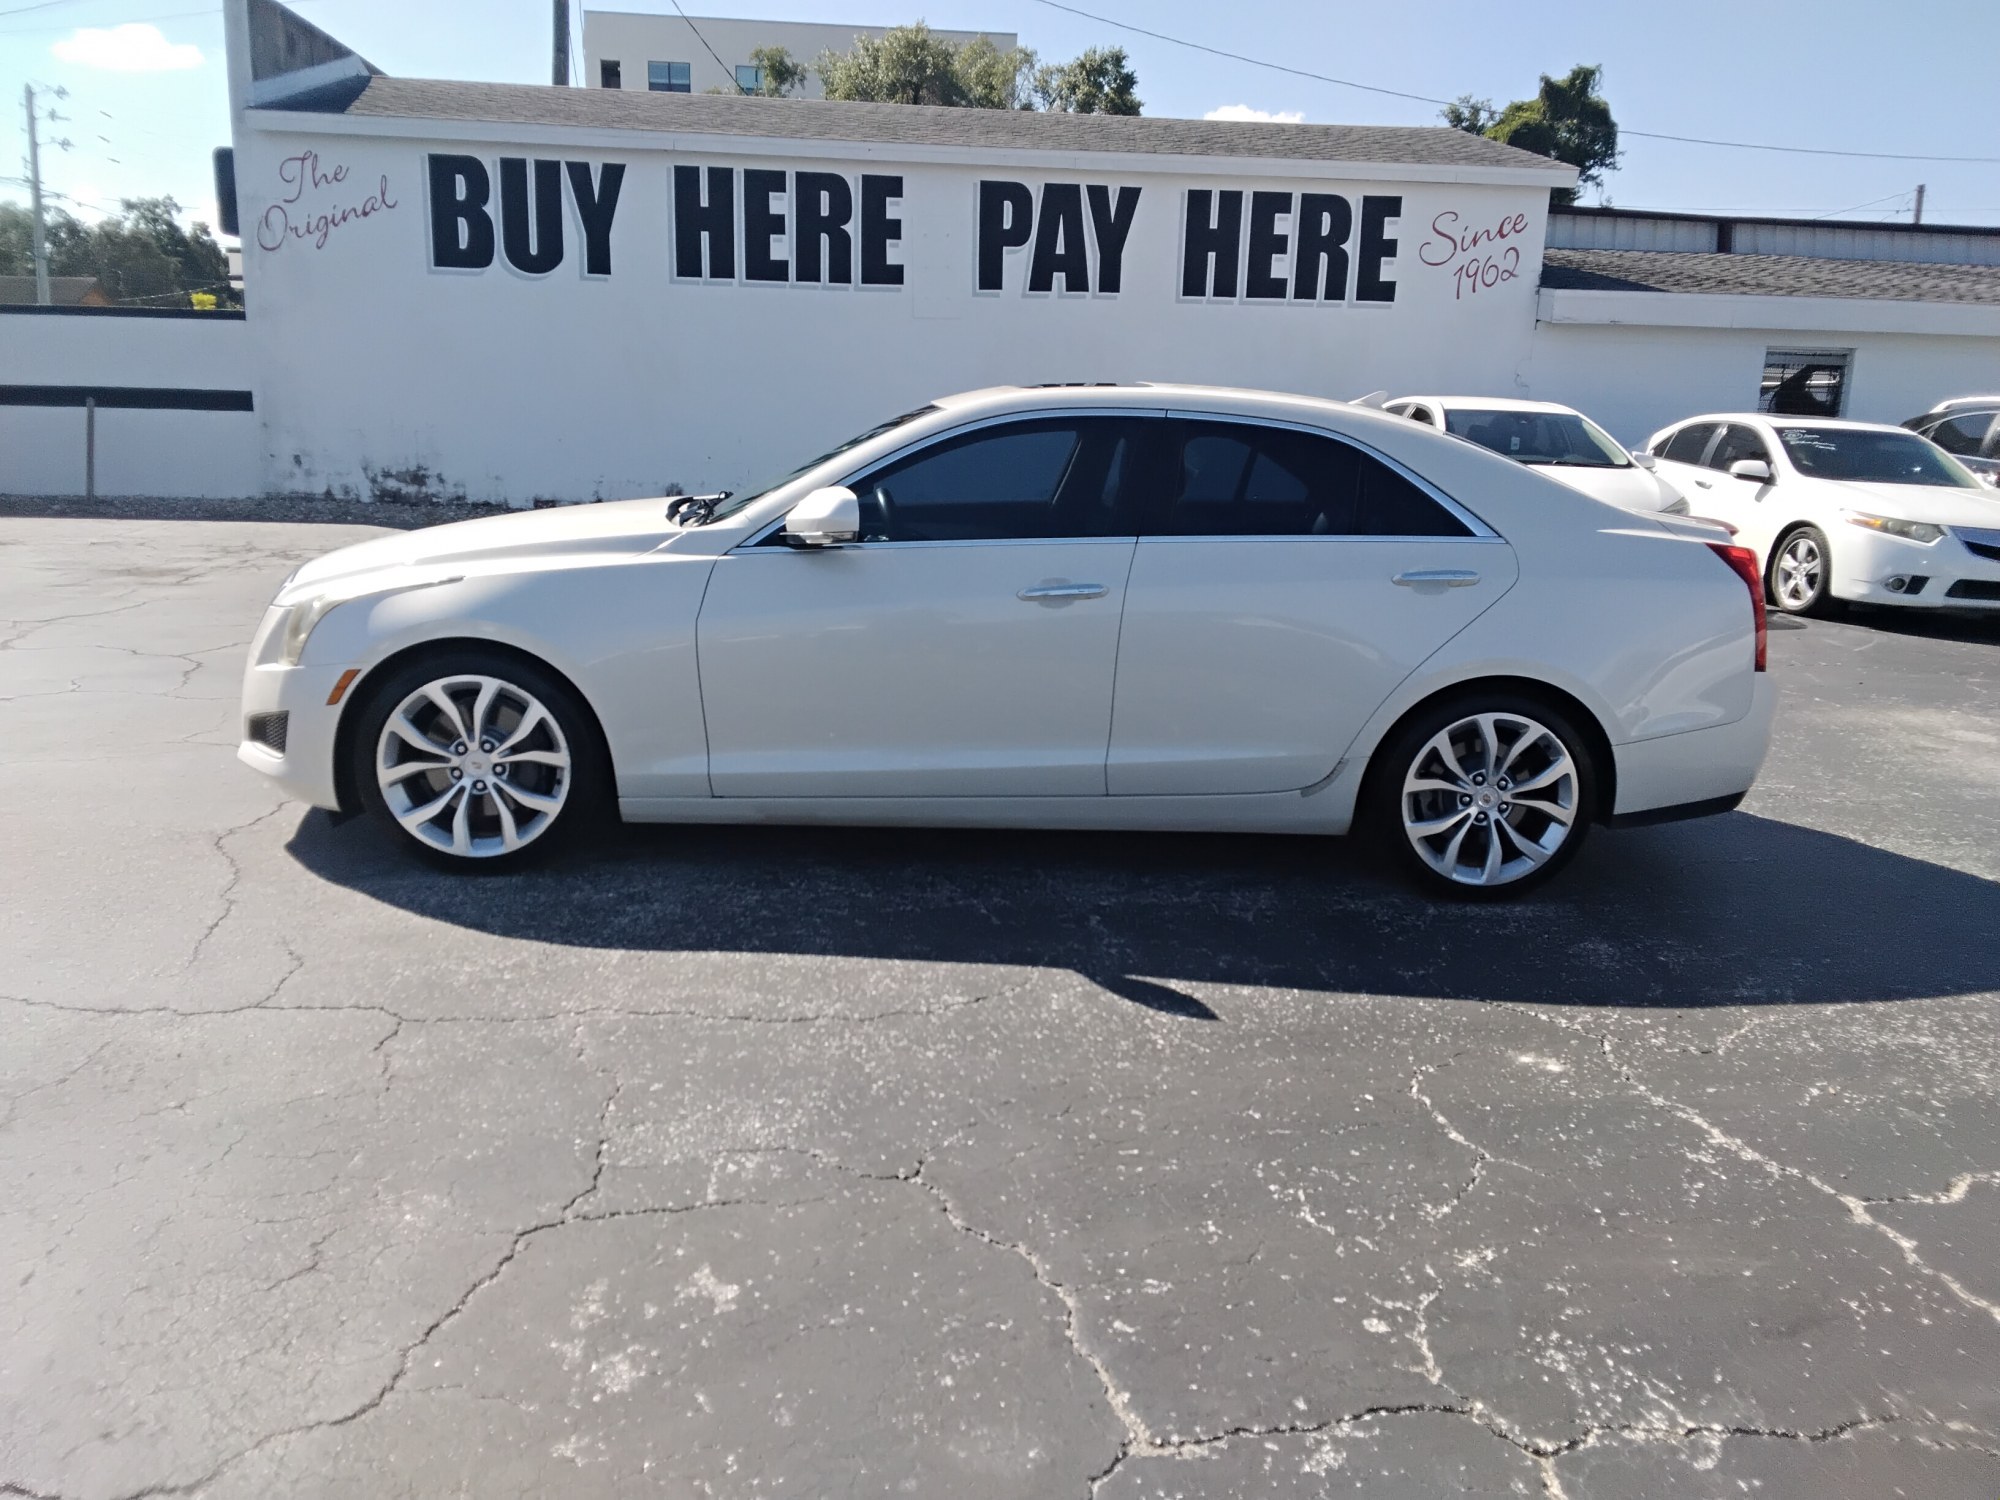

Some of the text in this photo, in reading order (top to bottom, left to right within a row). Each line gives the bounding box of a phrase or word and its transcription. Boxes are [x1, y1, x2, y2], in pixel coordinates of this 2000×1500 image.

[278, 150, 350, 204] The
[256, 175, 398, 251] Original
[426, 153, 1403, 303] BUY HERE PAY HERE
[1419, 210, 1529, 266] Since
[1452, 247, 1521, 300] 1962
